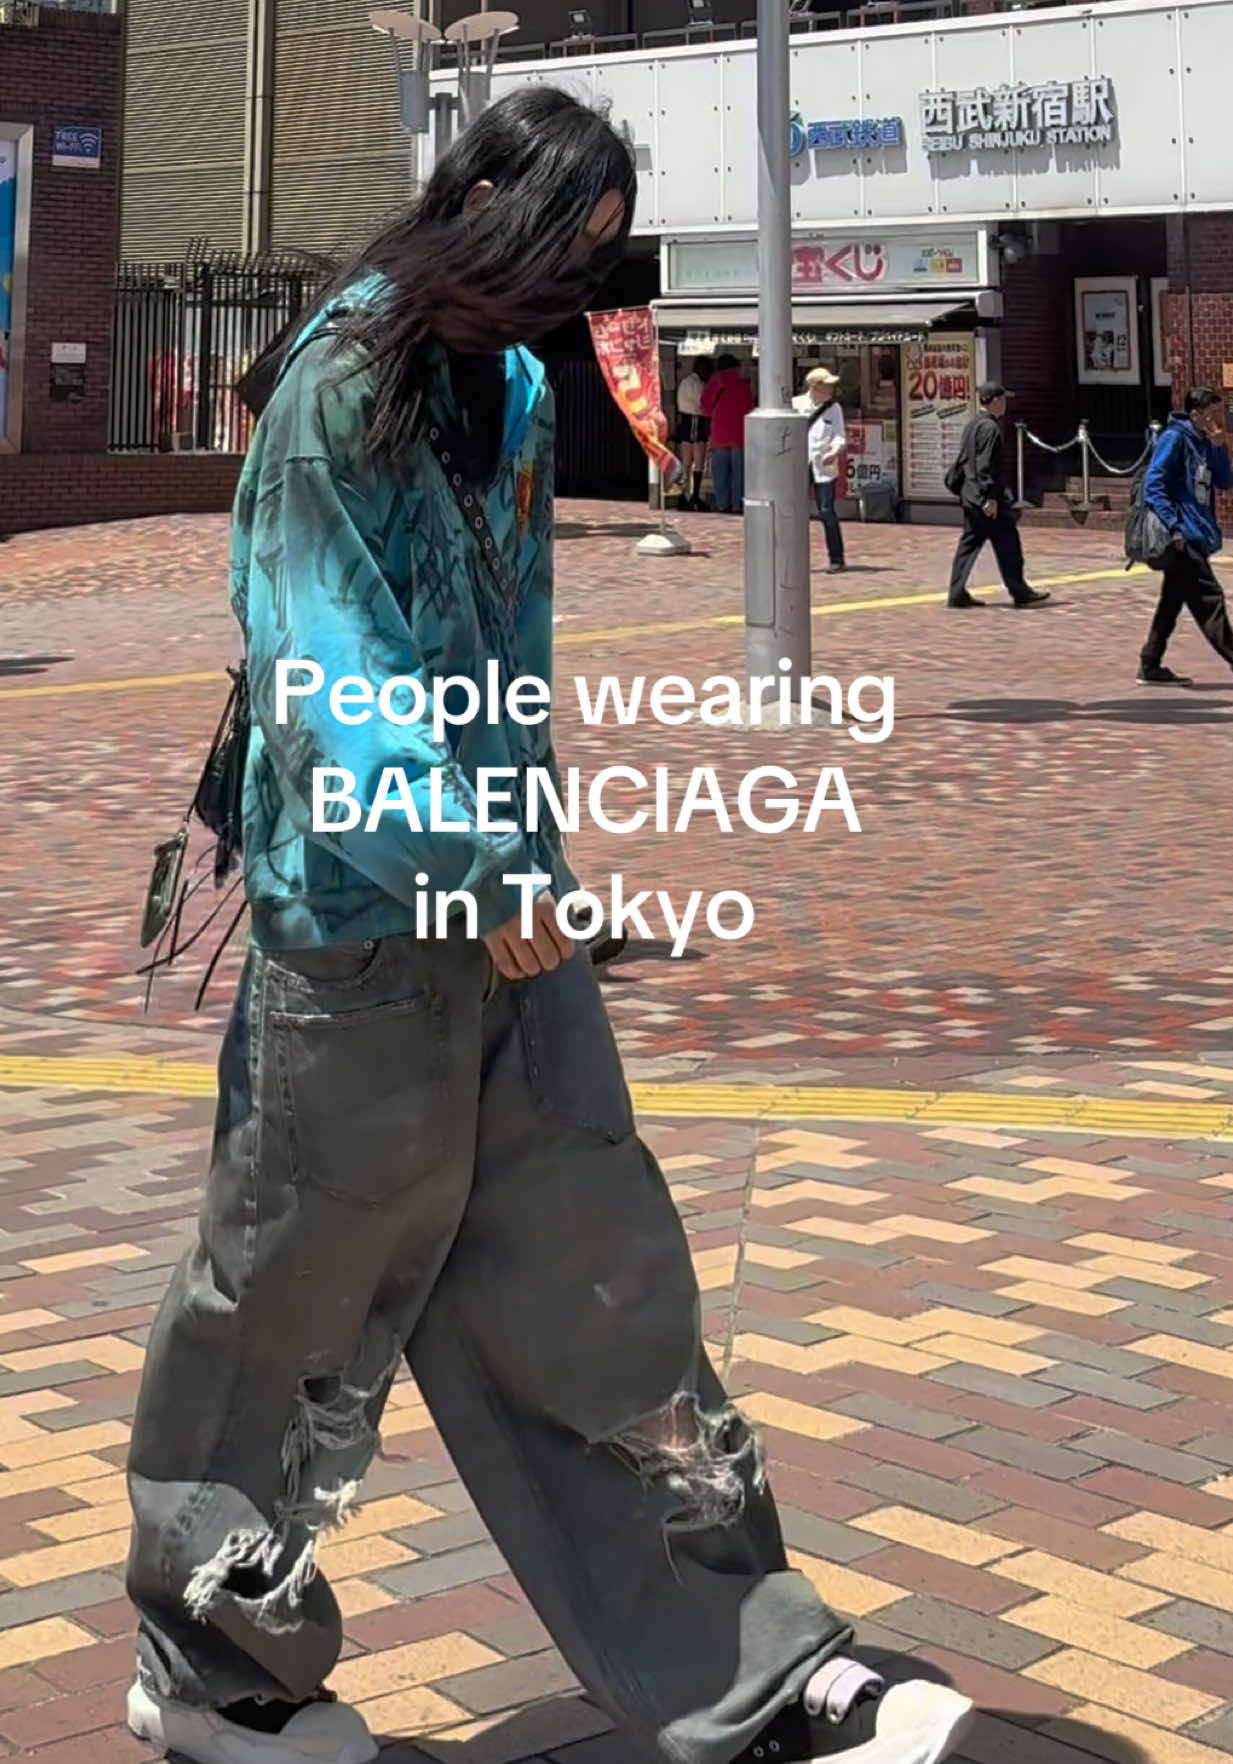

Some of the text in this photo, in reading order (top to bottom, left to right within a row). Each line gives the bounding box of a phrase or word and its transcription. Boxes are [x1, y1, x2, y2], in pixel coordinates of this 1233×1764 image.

[920, 77, 1114, 134] 西武新宿駅
[968, 129, 1040, 149] SHINJUKU
[1046, 124, 1112, 144] STATION
